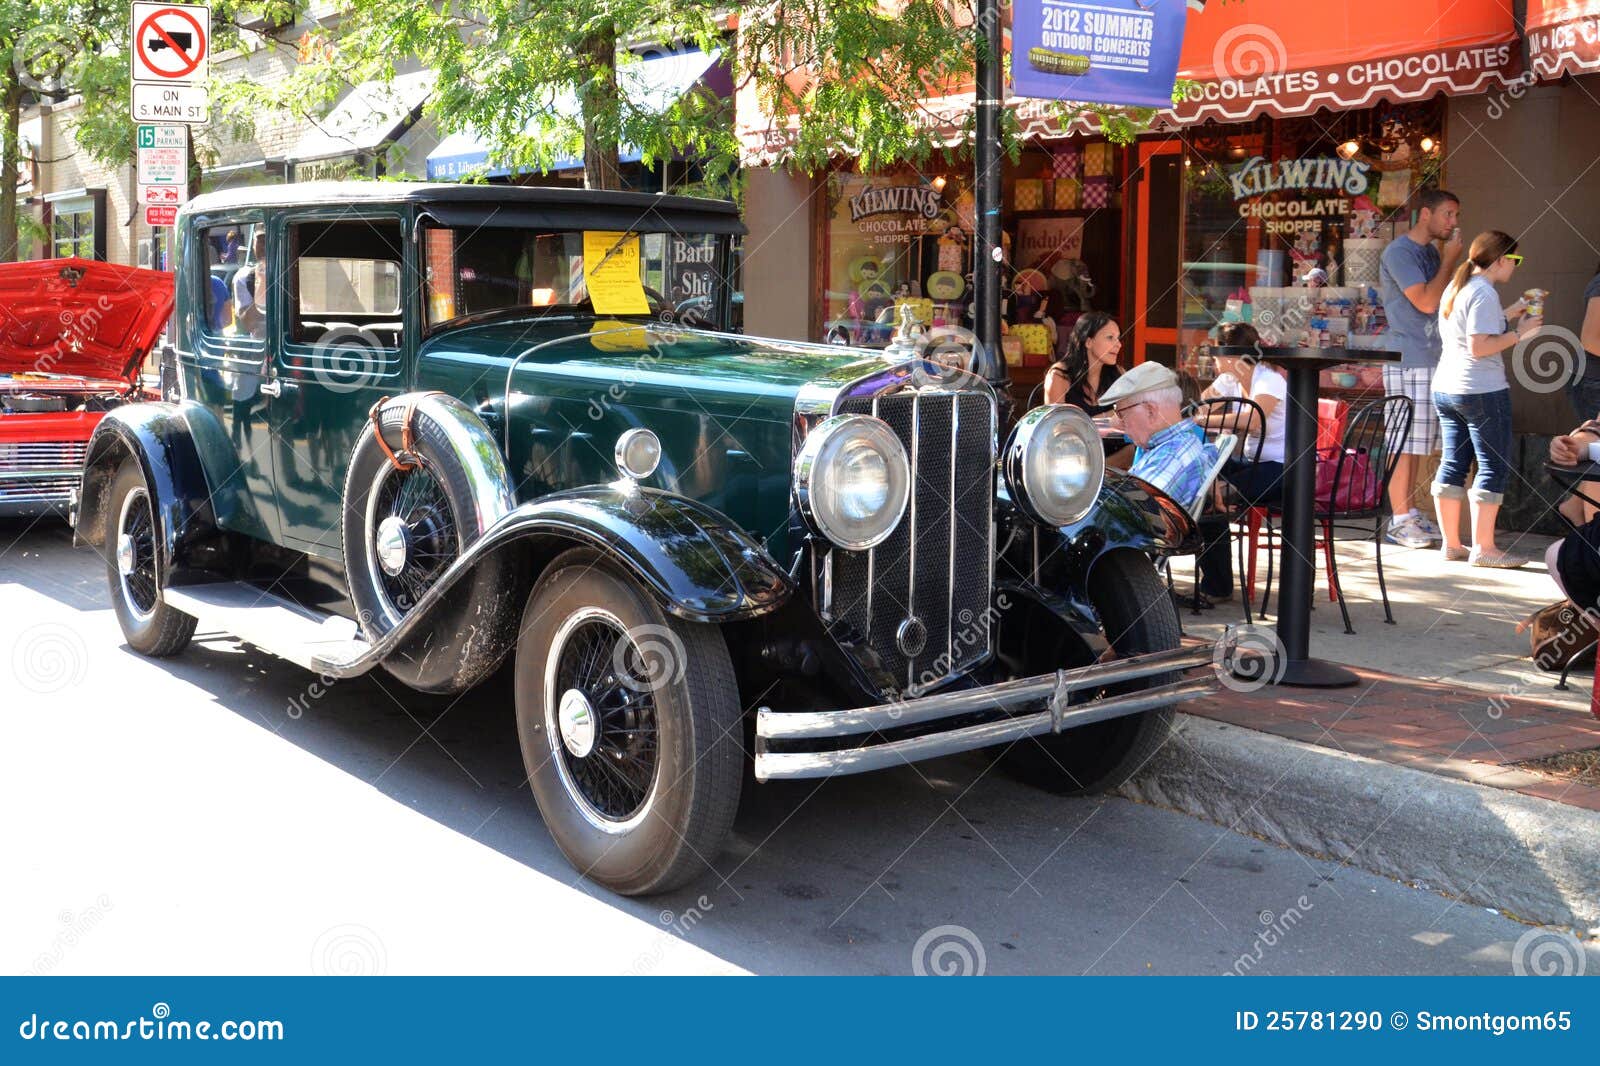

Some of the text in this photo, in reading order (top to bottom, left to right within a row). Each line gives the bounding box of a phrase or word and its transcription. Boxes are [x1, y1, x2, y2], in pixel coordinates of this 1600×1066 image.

[1041, 6, 1154, 41] 2012 SUMMER
[1041, 30, 1151, 57] OUTDOOR CONCERTS
[1346, 45, 1510, 86] CHOCOLATES
[163, 90, 179, 101] ON
[140, 105, 201, 117] S. MAIN ST
[140, 129, 154, 146] 15
[156, 137, 184, 145] PARKING
[1239, 199, 1350, 218] CHOCOLATE
[859, 218, 928, 233] CHOCOLATE
[1265, 220, 1322, 234] SHOPPE
[874, 234, 910, 244] SHOPPE
[1021, 229, 1080, 252] Indulge
